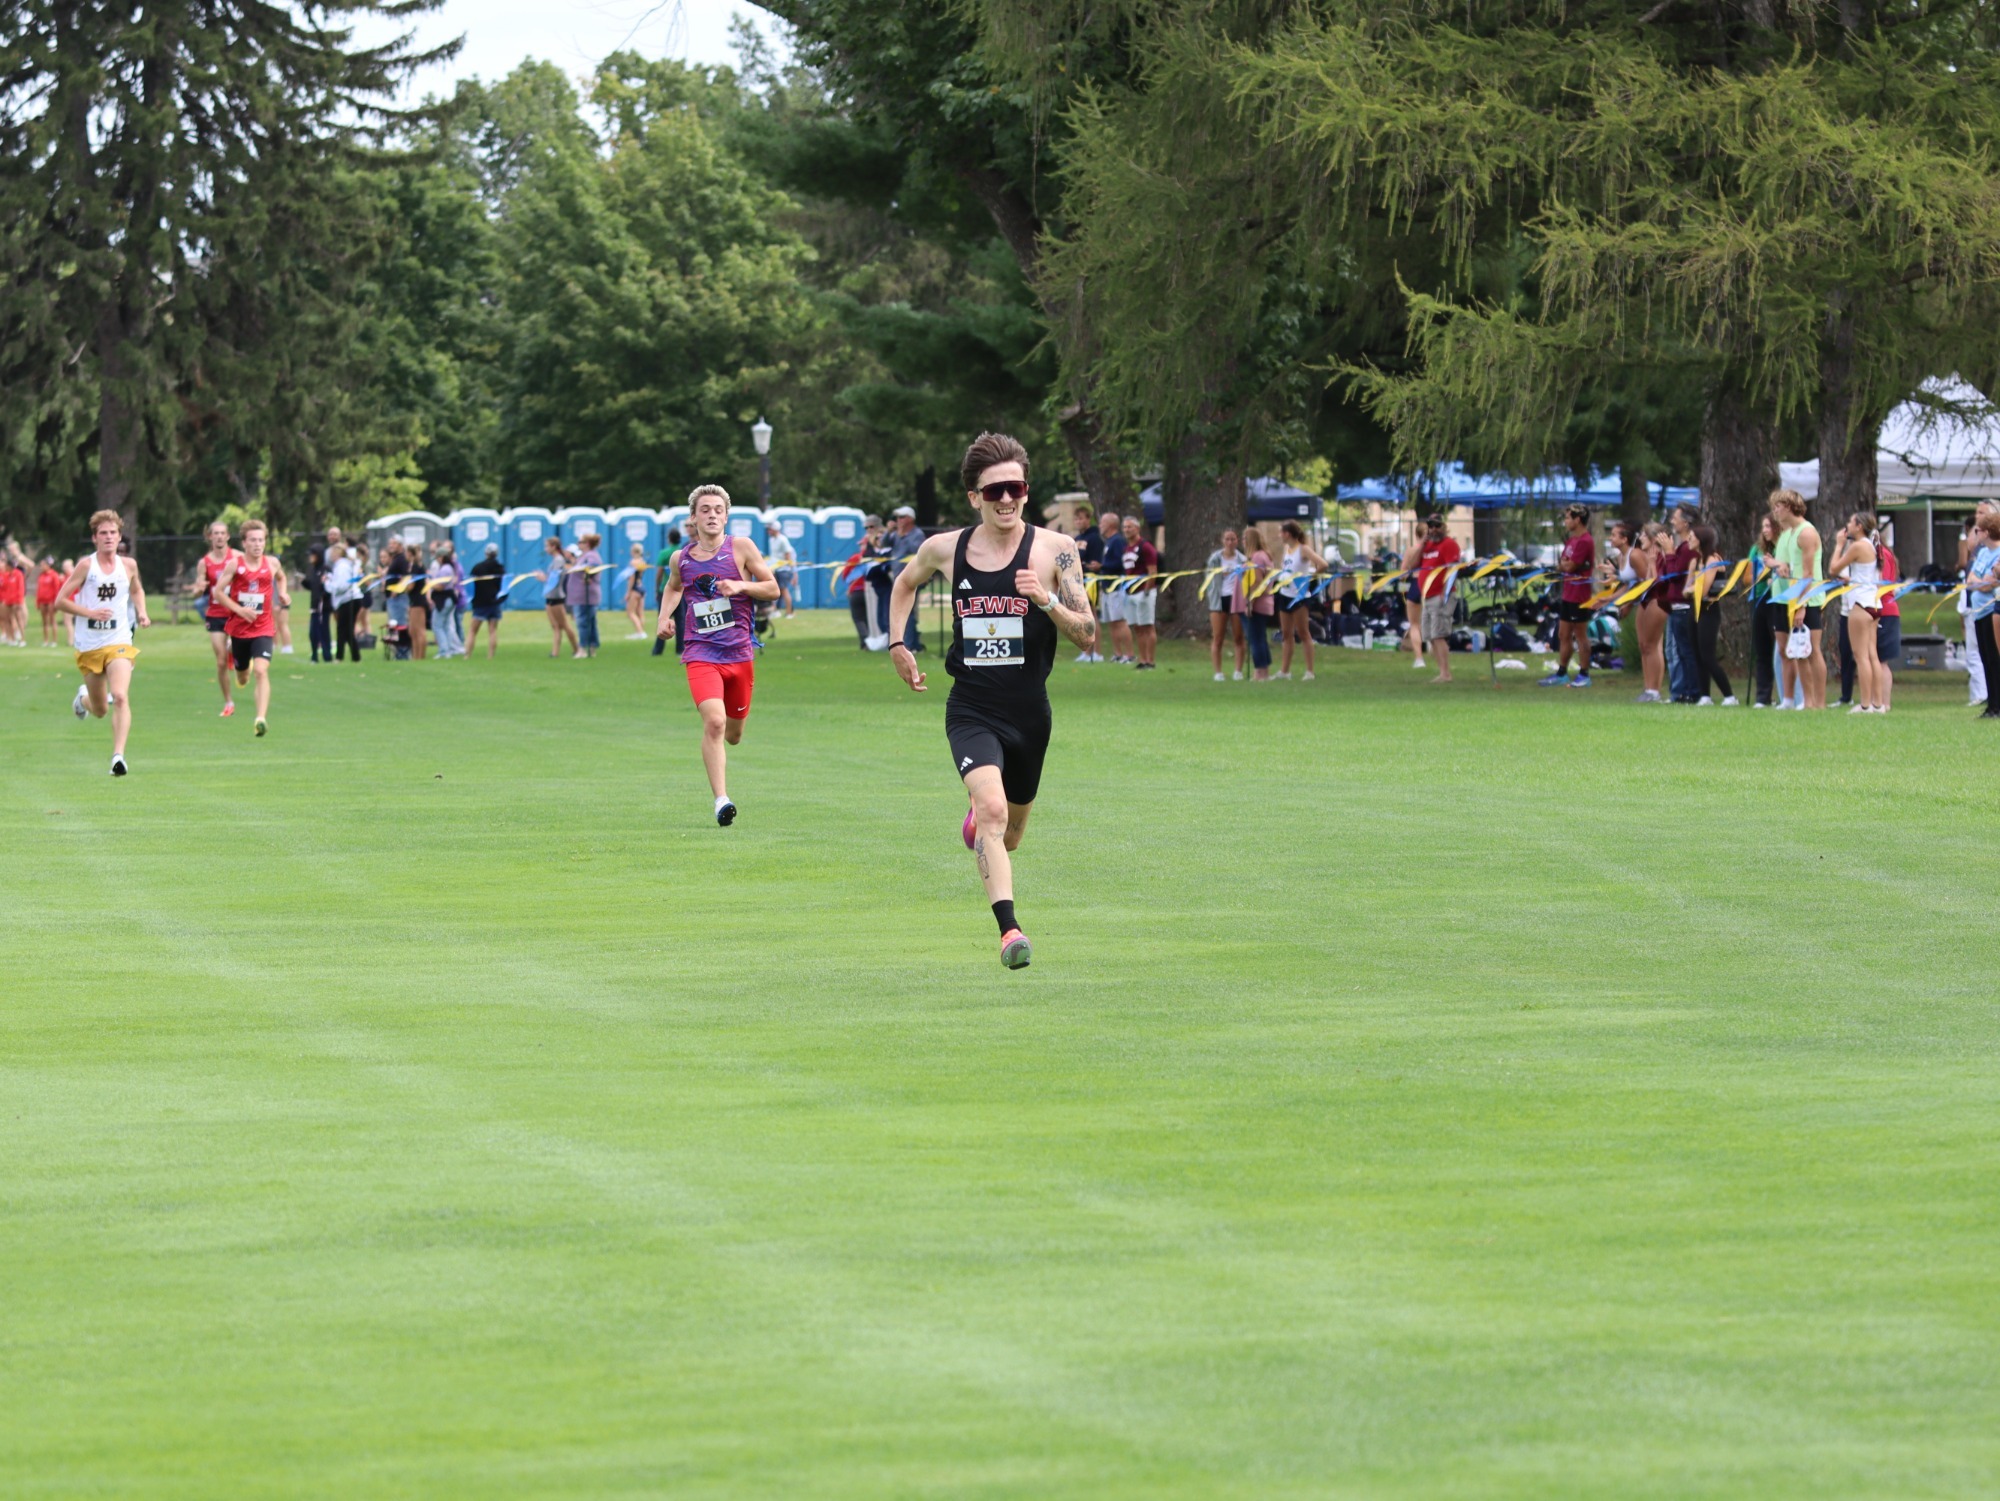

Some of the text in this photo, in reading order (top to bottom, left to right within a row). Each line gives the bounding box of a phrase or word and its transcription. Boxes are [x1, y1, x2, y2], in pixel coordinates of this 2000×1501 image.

[956, 596, 1028, 617] LEWIS
[93, 620, 112, 630] 414
[703, 613, 726, 628] 181
[975, 639, 1010, 658] 253
